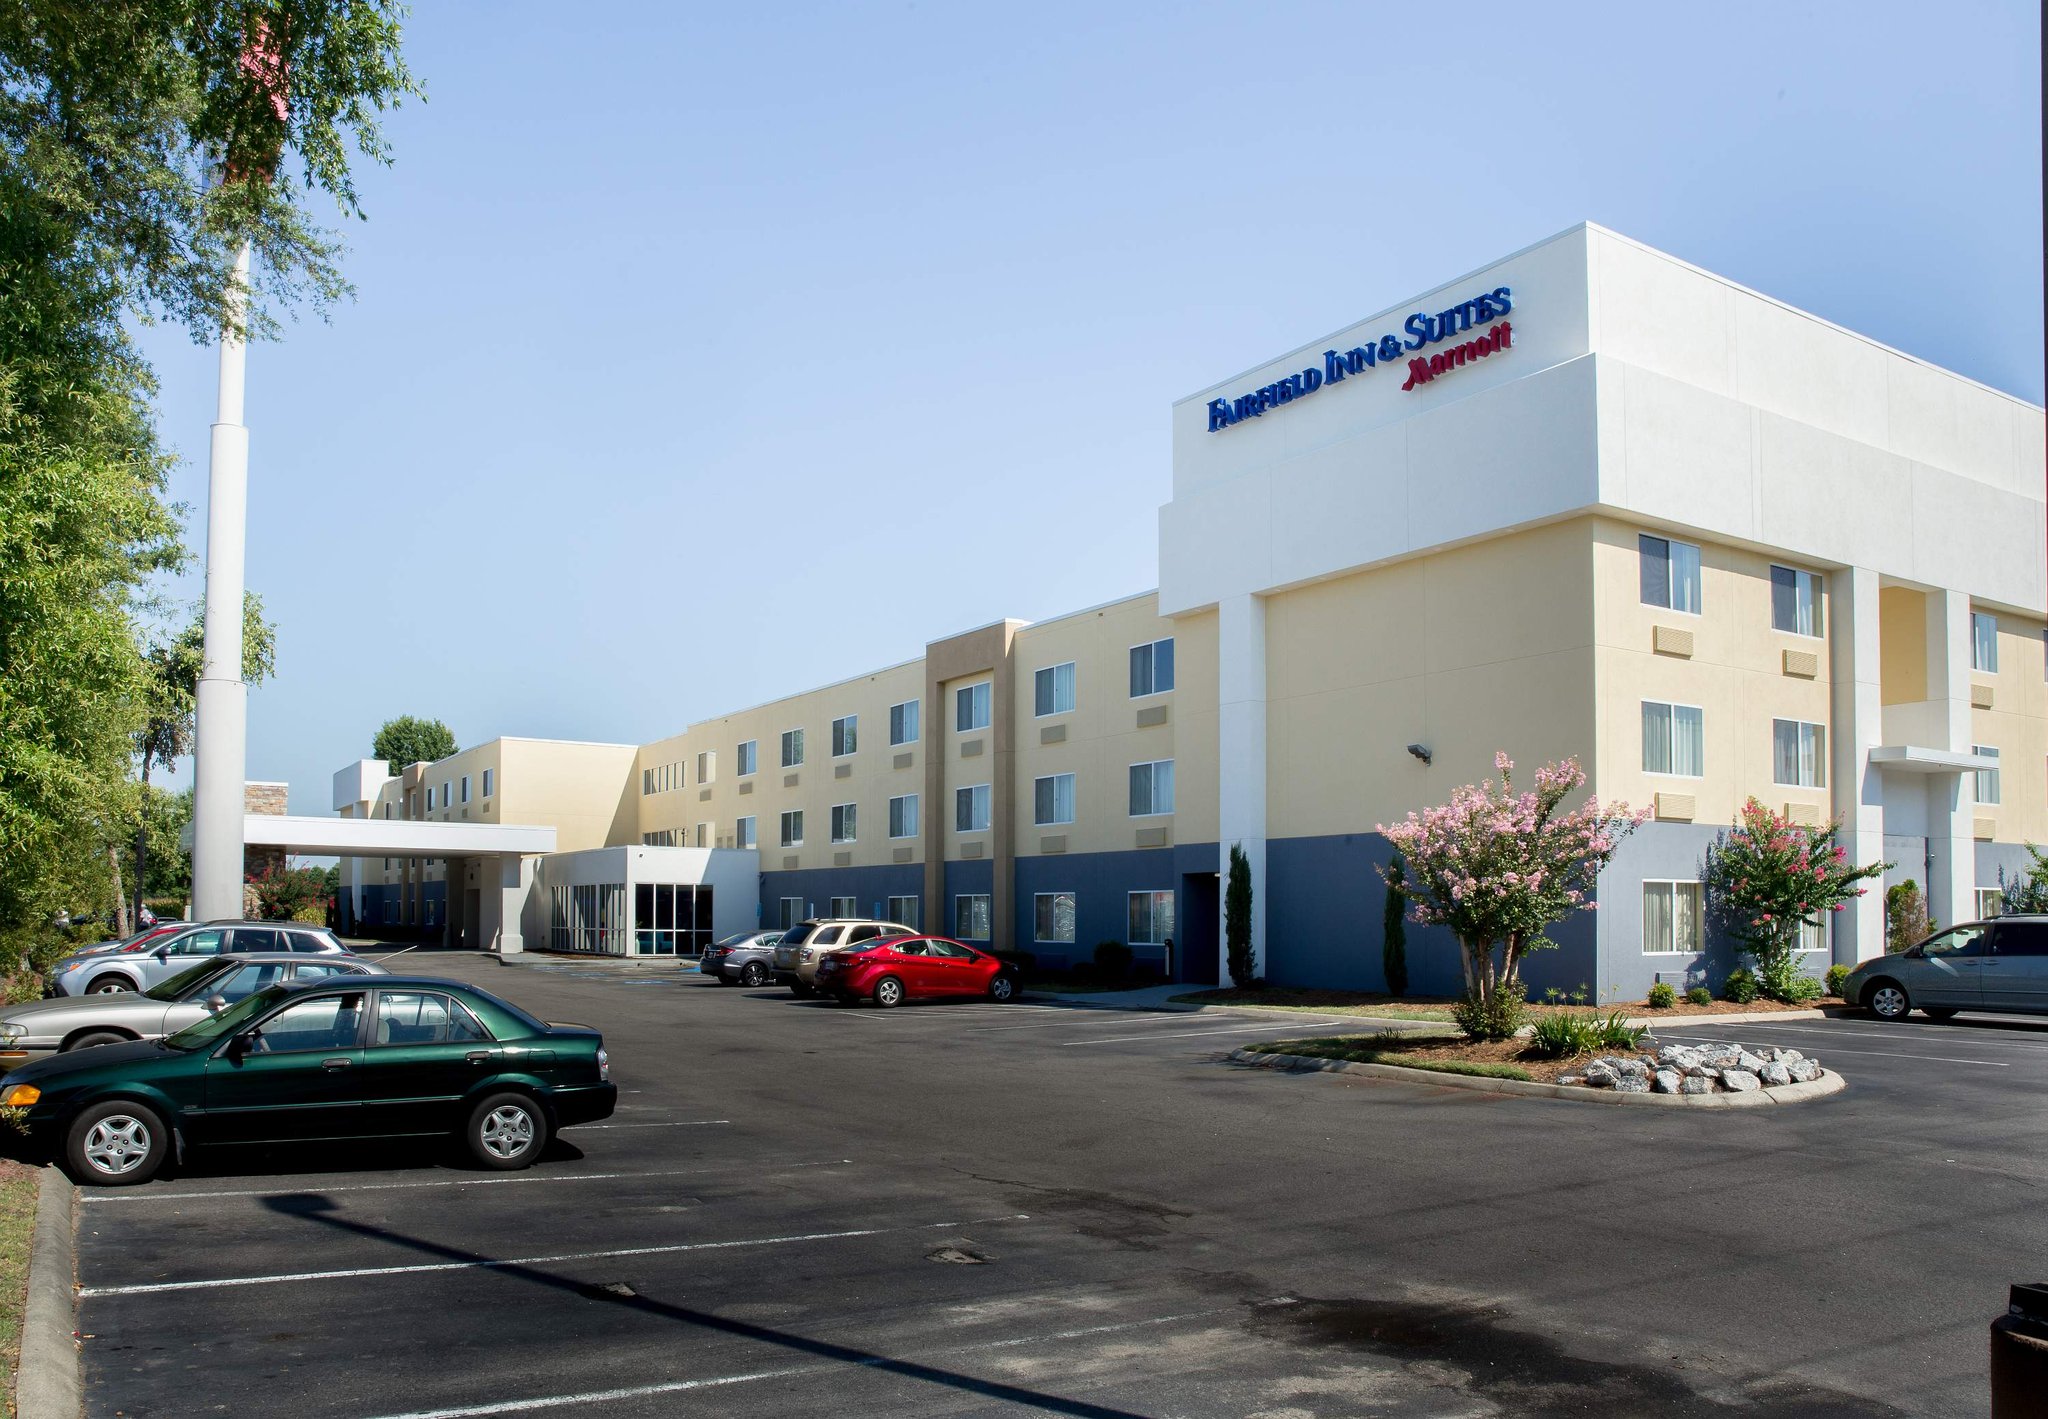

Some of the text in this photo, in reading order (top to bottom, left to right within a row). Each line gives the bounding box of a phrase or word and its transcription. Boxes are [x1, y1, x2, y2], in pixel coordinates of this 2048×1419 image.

[1207, 287, 1511, 432] FAIRFIELD INN & SUITES
[1402, 321, 1512, 391] Marriott
